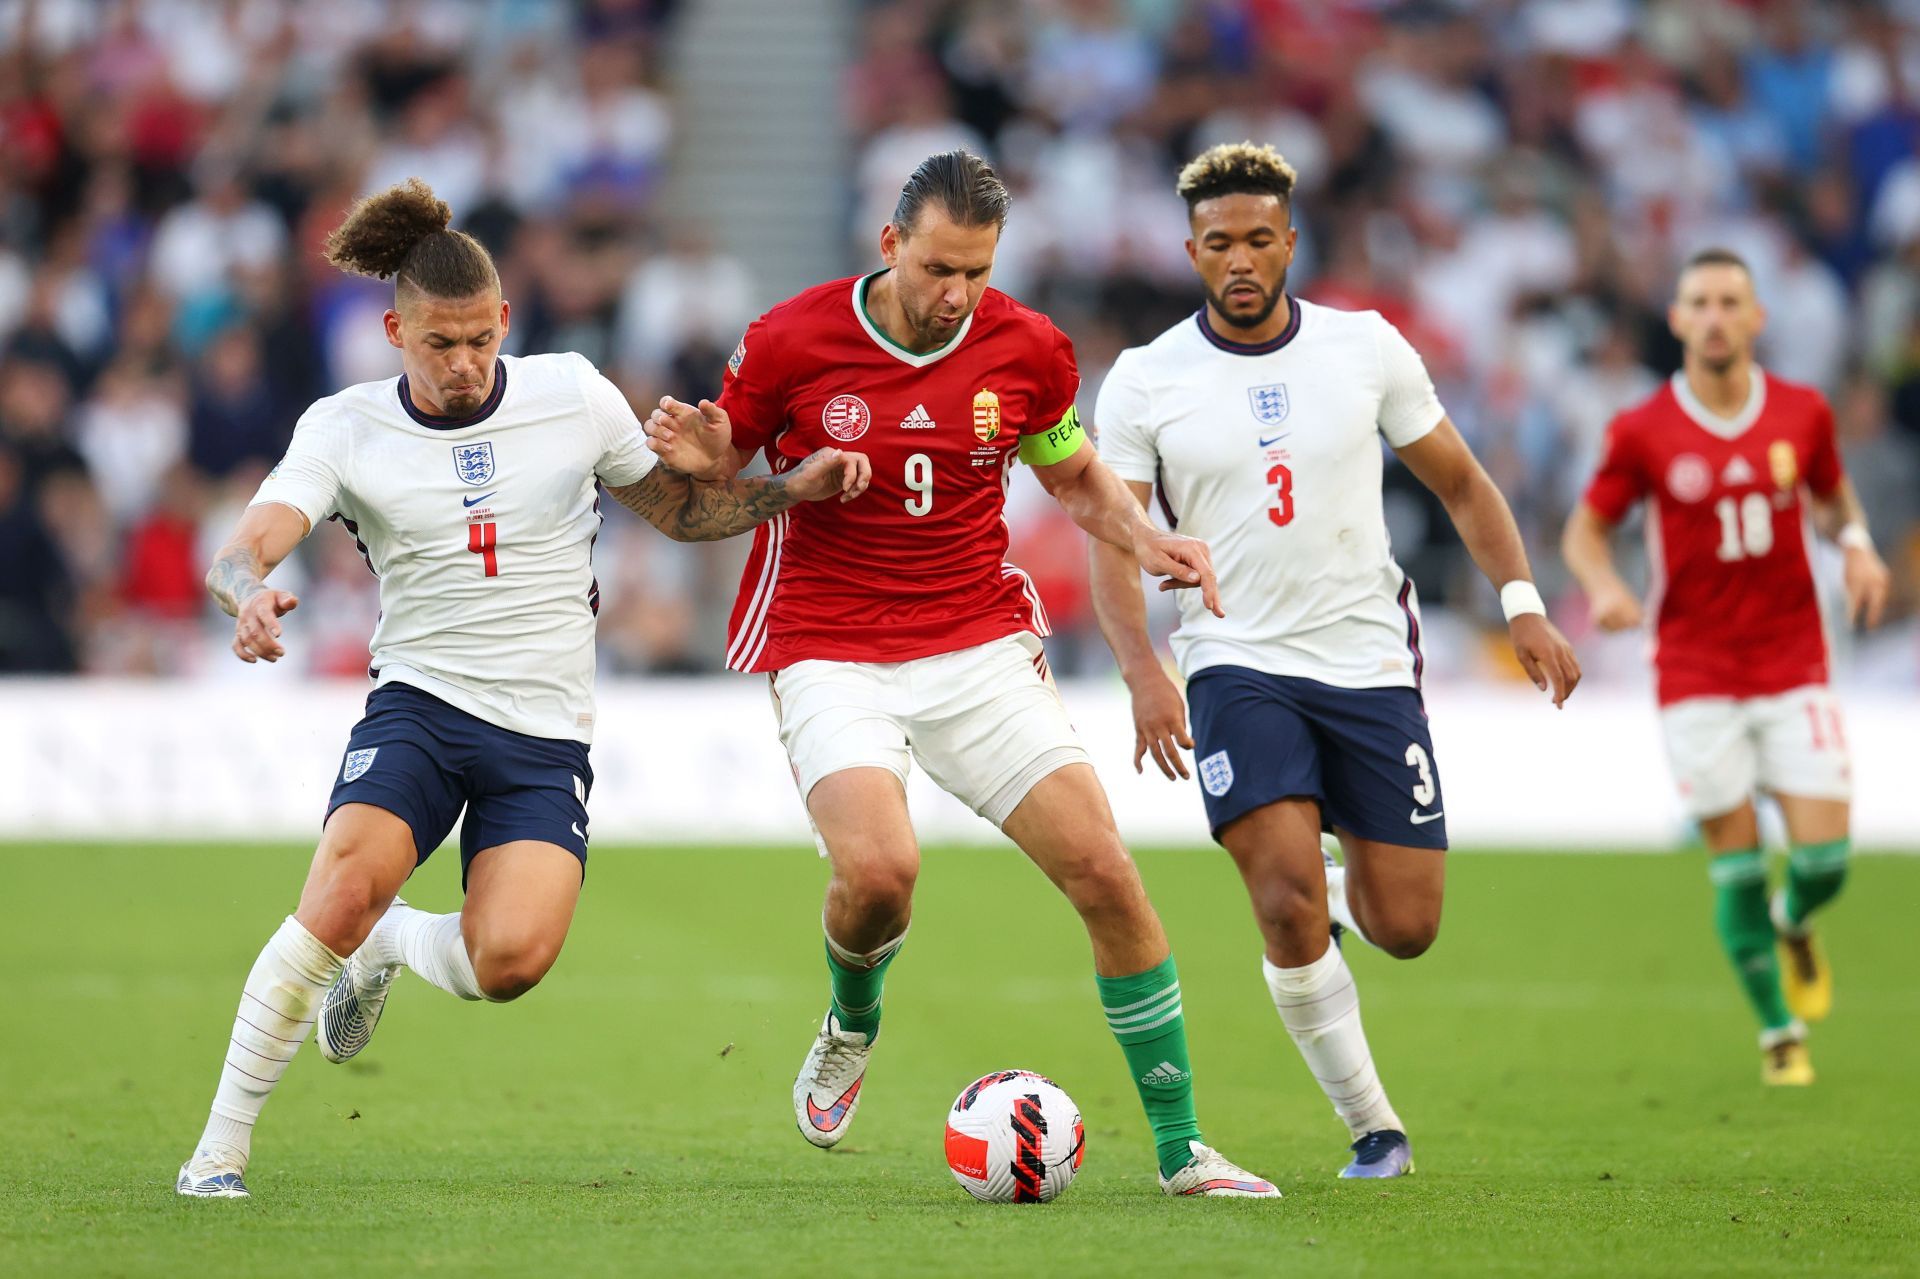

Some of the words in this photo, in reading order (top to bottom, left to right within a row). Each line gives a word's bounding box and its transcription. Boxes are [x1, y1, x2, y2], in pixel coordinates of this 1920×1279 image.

[900, 420, 936, 429] adidas
[904, 453, 933, 517] 9
[1266, 464, 1295, 528] 3
[468, 522, 498, 577] 4
[1405, 742, 1435, 807] 3
[1141, 1071, 1190, 1085] adidas
